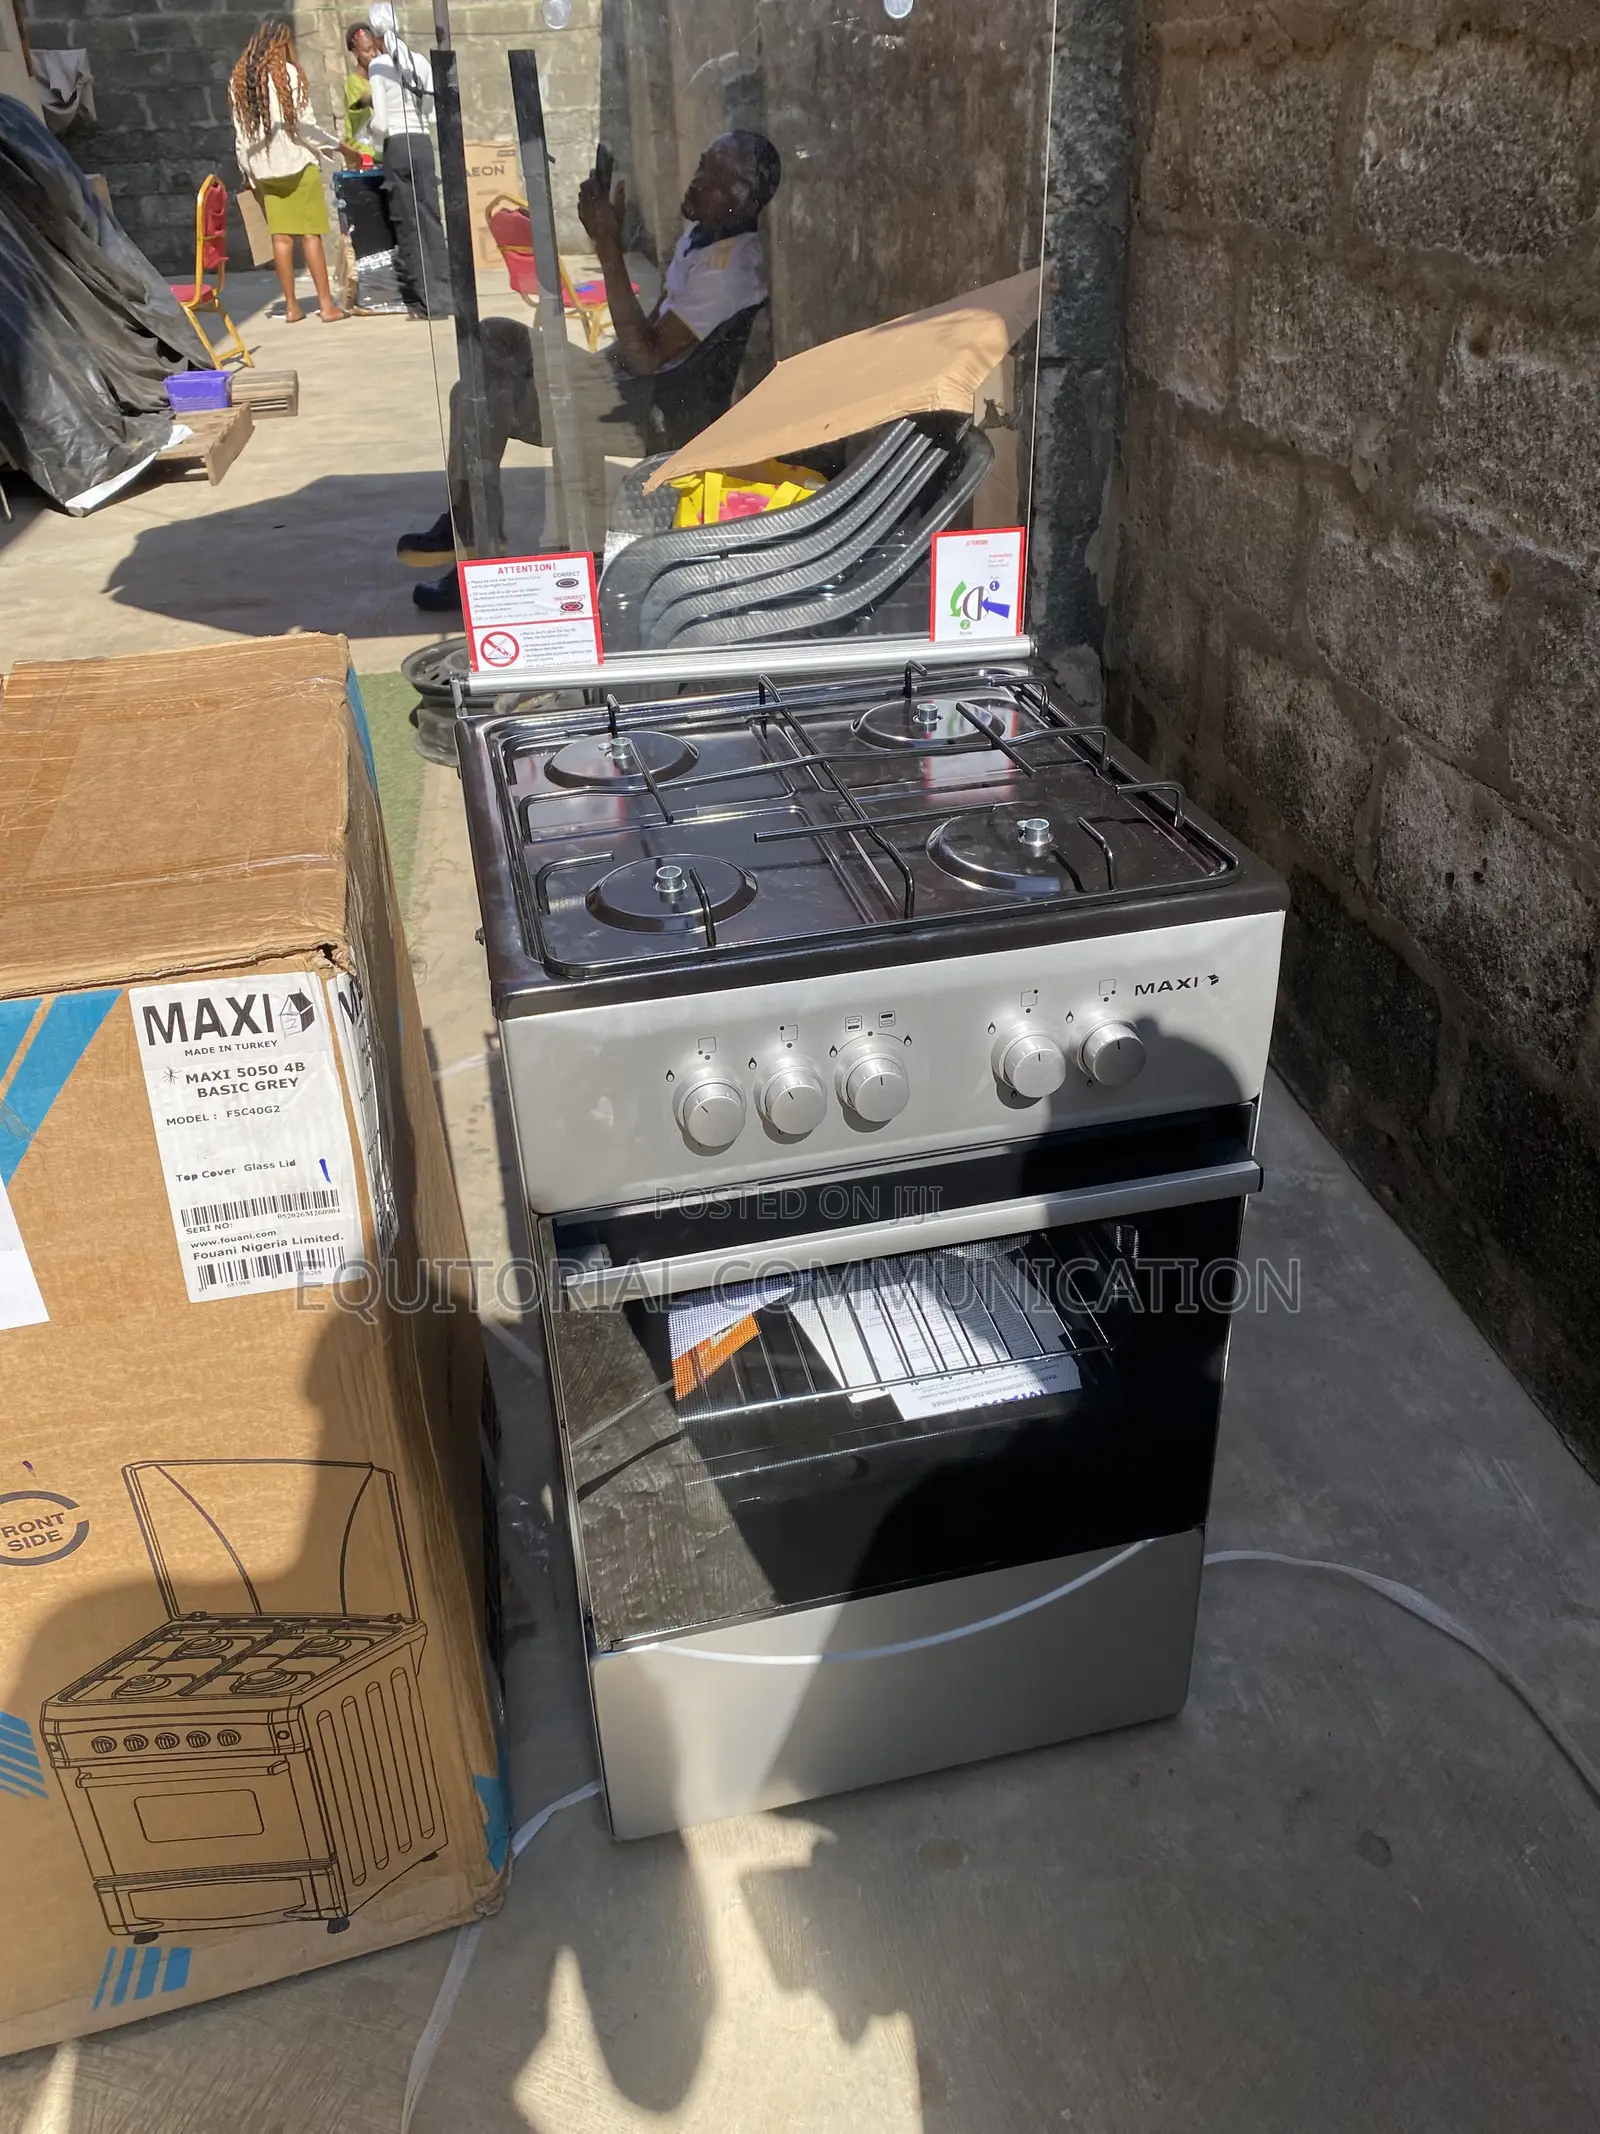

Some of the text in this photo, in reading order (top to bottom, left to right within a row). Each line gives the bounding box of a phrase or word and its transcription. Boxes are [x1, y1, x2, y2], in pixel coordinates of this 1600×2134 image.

[498, 563, 556, 574] ATTENTION!
[1135, 976, 1198, 996] MAXI
[142, 993, 275, 1046] MAXI
[184, 1039, 278, 1057] MADE IN TURKEY
[186, 1061, 306, 1085] MAXI 5050 4B
[197, 1077, 299, 1098] BASIC GREY
[226, 1105, 281, 1118] F5C40G2
[176, 1159, 297, 1182] Top Cover Glass Lid
[215, 1222, 233, 1231] NO:
[190, 1230, 277, 1249] www.fouani.com
[193, 1233, 344, 1261] Fouani Nigeria Limited.
[0, 1512, 64, 1539] RONT
[7, 1530, 63, 1551] SIDE
